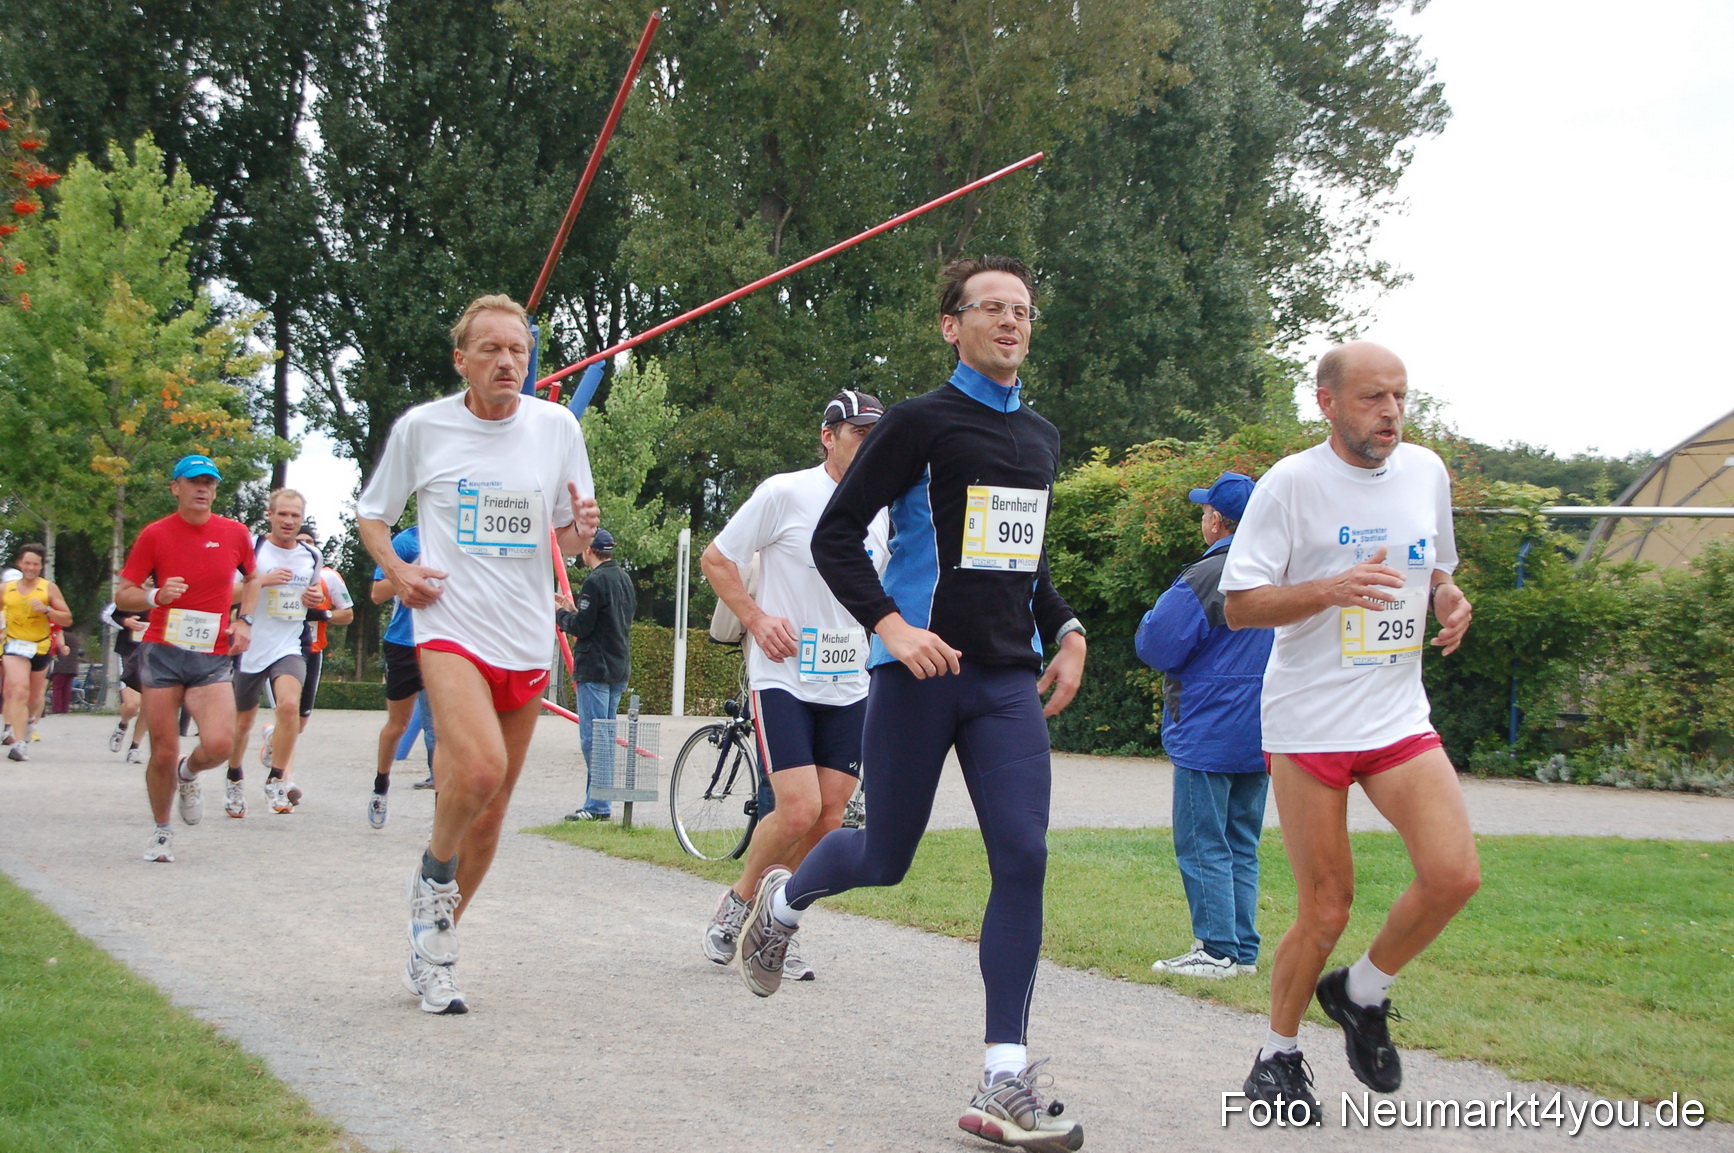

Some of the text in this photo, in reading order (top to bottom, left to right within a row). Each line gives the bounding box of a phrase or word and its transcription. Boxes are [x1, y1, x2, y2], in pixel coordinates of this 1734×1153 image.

[484, 495, 529, 509] Friedrich
[992, 494, 1038, 513] Bernhard
[464, 513, 470, 522] A
[969, 518, 975, 529] B
[484, 515, 531, 533] 3069
[998, 521, 1034, 545] 909
[1352, 528, 1387, 536] Neumarkter
[1361, 535, 1387, 543] Stadtlauf
[283, 601, 300, 610] 448
[1346, 620, 1352, 631] A
[1377, 619, 1415, 641] 295
[185, 626, 211, 640] 315
[822, 633, 849, 643] Michael
[822, 648, 856, 663] 3002
